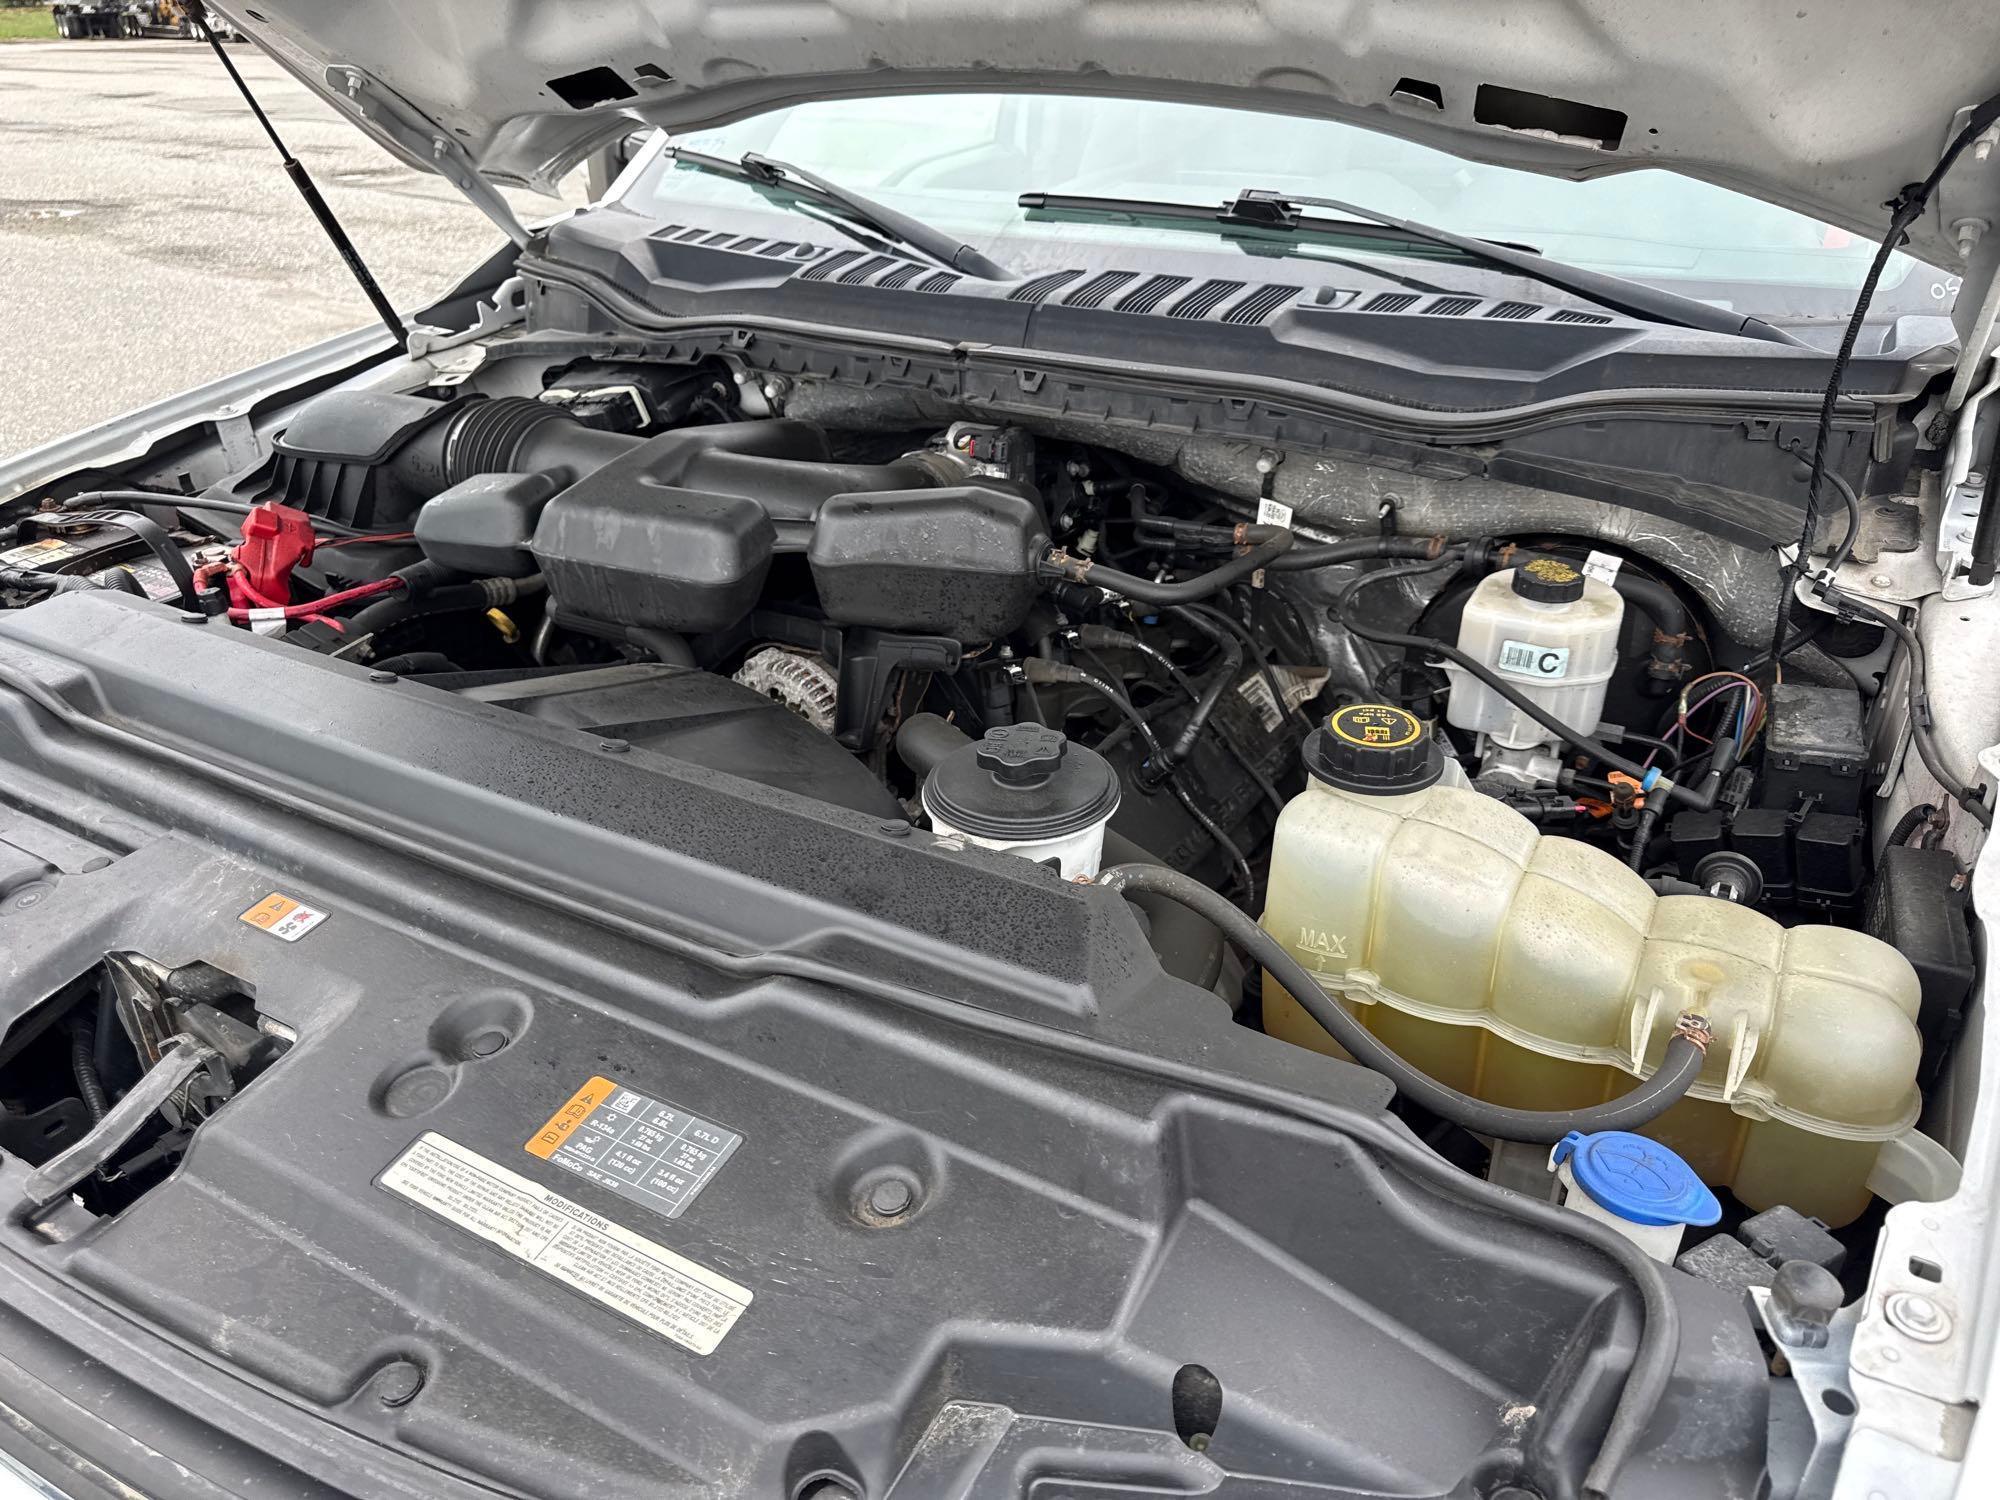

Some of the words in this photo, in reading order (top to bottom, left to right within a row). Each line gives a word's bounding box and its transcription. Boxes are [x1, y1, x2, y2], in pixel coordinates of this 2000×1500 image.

[1538, 653, 1560, 673] C
[1300, 927, 1346, 954] MAX
[590, 1119, 614, 1134] R-134a
[575, 1142, 592, 1153] PAG
[552, 1153, 582, 1171] FoMoCo
[586, 1170, 602, 1180] SAE
[544, 1194, 608, 1230] MODIFICATIONS
